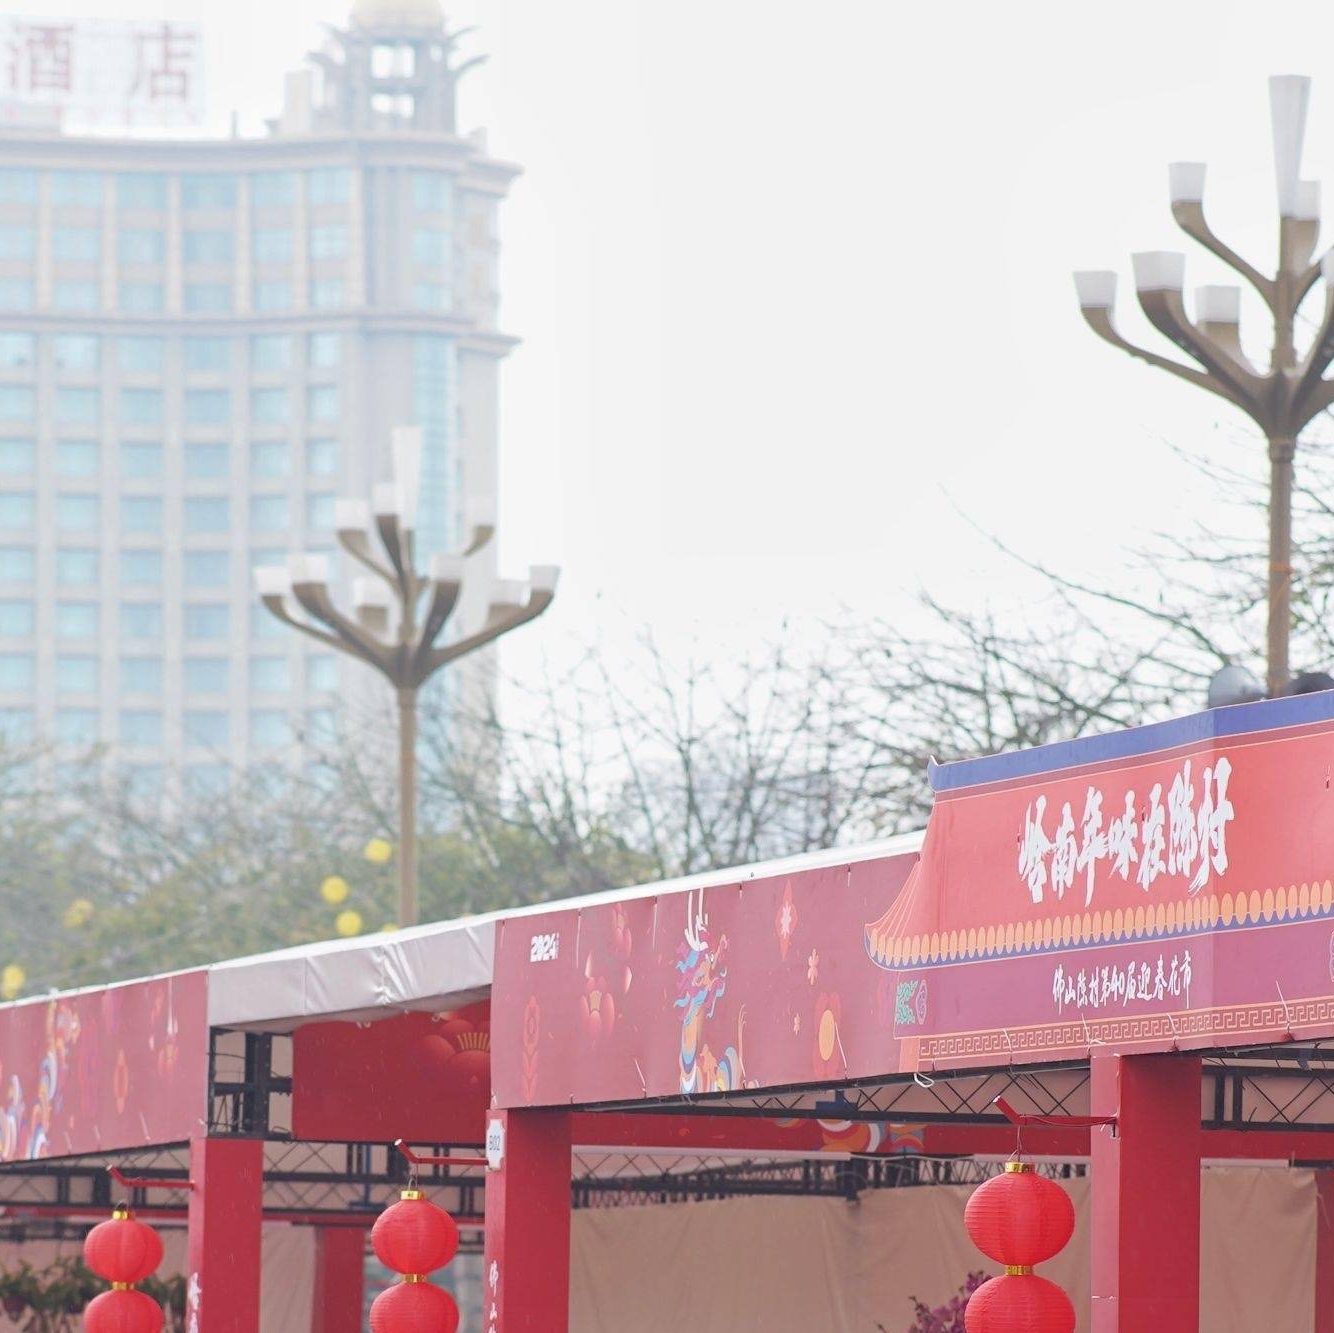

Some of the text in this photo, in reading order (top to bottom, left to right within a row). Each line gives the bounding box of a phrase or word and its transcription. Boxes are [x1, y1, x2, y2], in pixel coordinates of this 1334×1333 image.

[1019, 757, 1234, 907] 岭南年味在陈村
[1052, 950, 1192, 1015] 佛山陈村第40届迎春花市
